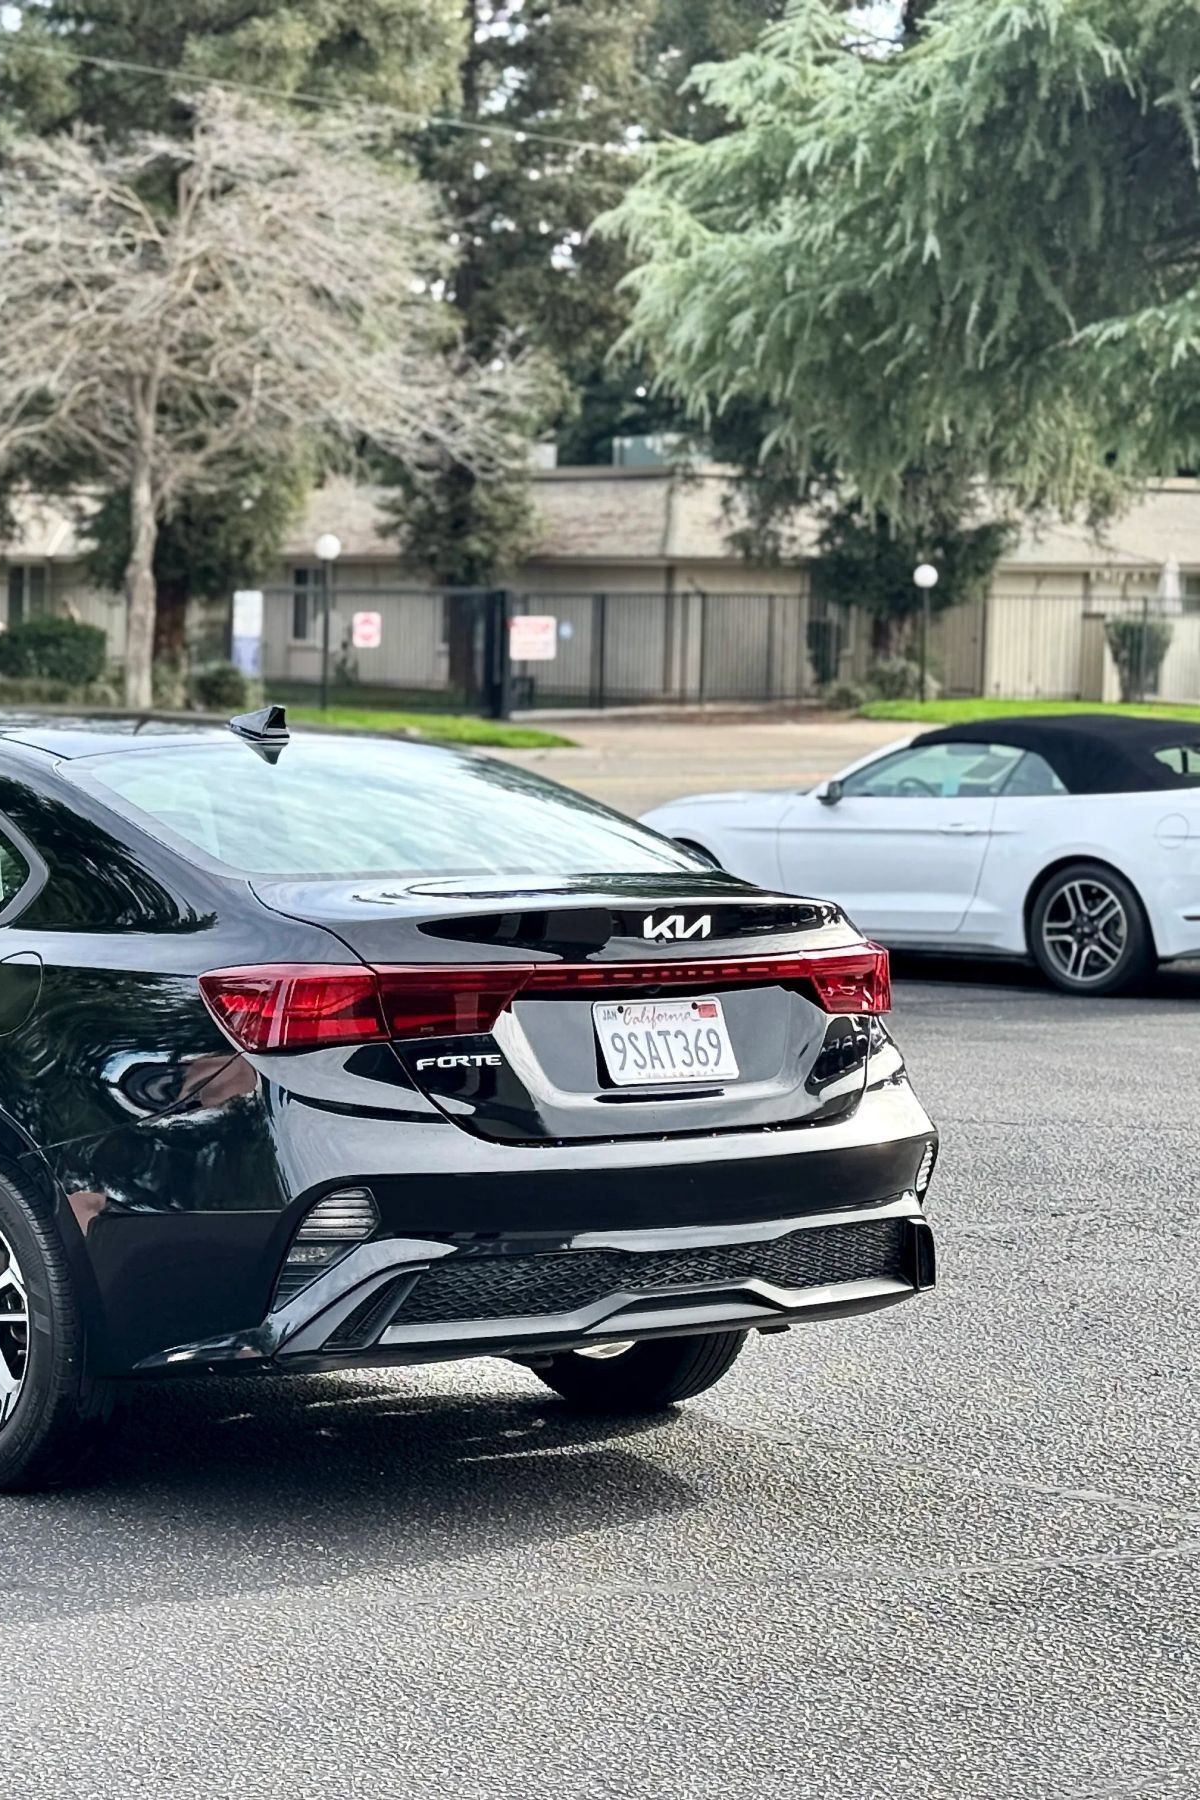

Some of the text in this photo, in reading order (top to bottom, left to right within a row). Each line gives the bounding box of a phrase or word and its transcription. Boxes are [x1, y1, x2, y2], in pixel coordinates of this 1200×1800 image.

[643, 914, 711, 939] KIA
[603, 1009, 617, 1021] JAN
[623, 1006, 699, 1029] California
[611, 1028, 722, 1071] 9SAT369
[416, 1054, 502, 1071] FORTE
